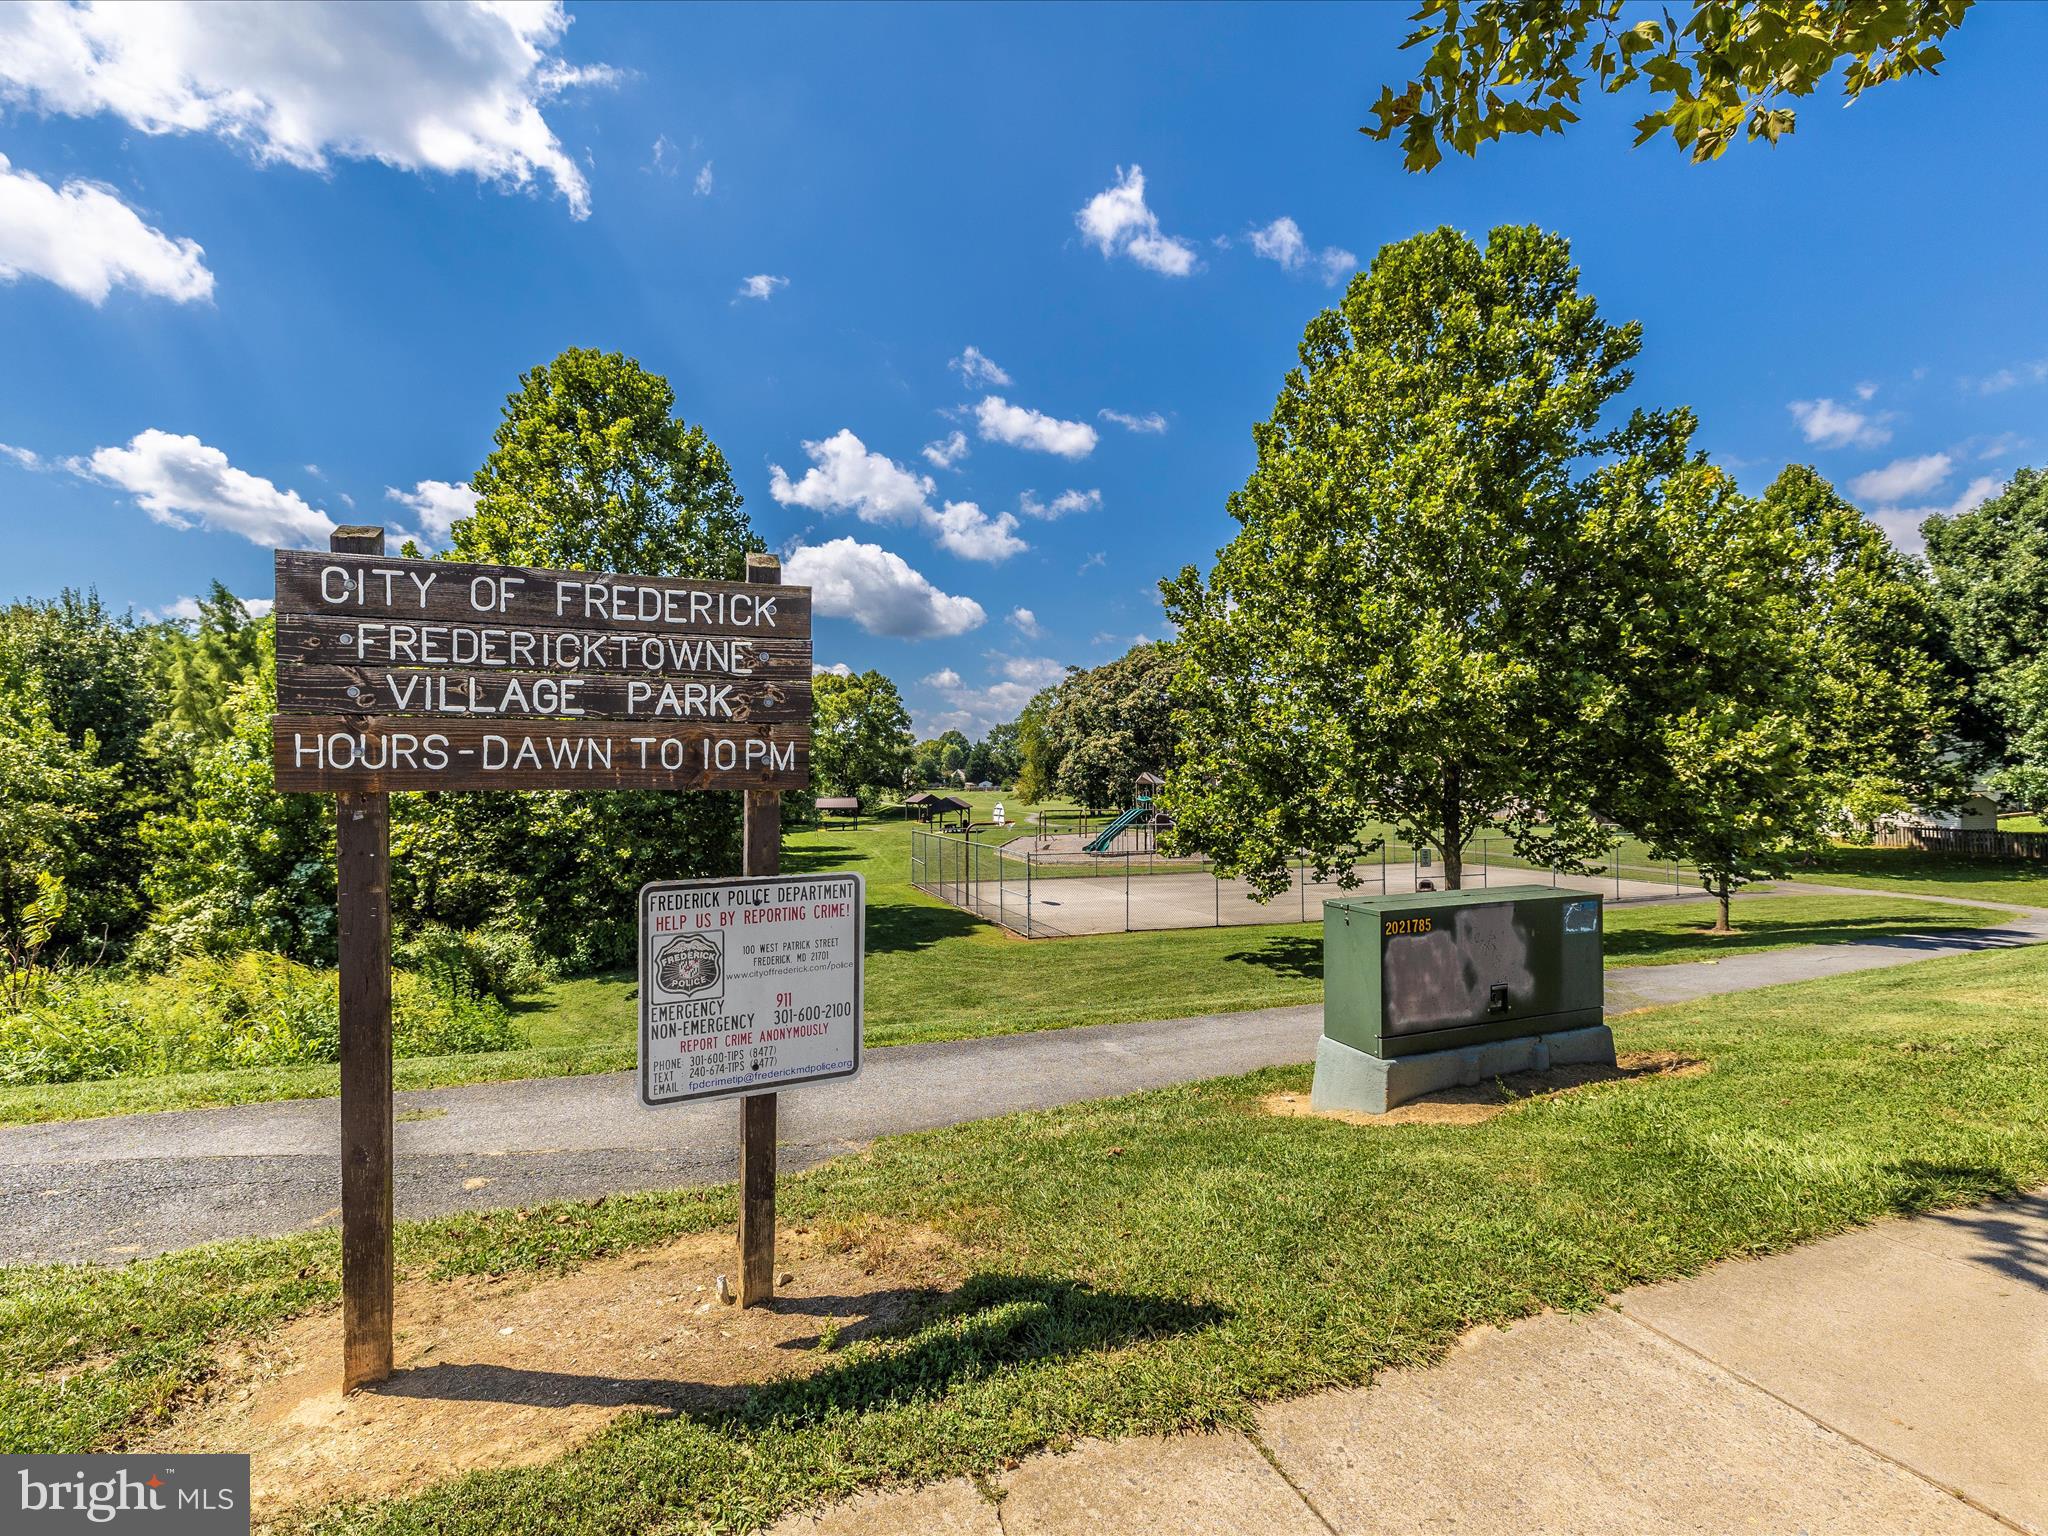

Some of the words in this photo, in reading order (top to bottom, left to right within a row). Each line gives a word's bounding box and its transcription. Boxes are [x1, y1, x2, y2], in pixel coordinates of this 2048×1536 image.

[321, 566, 436, 608] CITY
[470, 576, 525, 612] OF
[556, 582, 776, 627] FREDERICK
[358, 624, 752, 673] FREDERICKTOWNE
[386, 674, 585, 715] VILLAGE
[628, 682, 732, 717] PARK
[631, 737, 683, 771] TO
[650, 891, 720, 912] FREDERICK
[728, 888, 770, 906] POLICE
[778, 883, 854, 902] DEPARTMENT
[656, 915, 687, 931] HELP
[696, 913, 711, 928] US
[720, 911, 735, 927] BY
[744, 906, 806, 924] REPORTING
[814, 903, 850, 919] CRIME!
[1385, 918, 1432, 936] 2021785
[661, 951, 716, 967] FREDERICK
[743, 945, 755, 955] 100
[760, 943, 778, 953] WEST
[783, 940, 811, 951] PATRICK
[815, 938, 839, 949] STREET
[797, 953, 807, 963] MD
[811, 951, 829, 961] 21701
[672, 976, 707, 987] POLICE
[726, 961, 853, 980] www.cityoffrederick.com/police
[651, 1000, 725, 1023] EMERGENCY
[776, 992, 792, 1008] 911
[651, 1013, 755, 1041] NON-EMERGENCY
[774, 1002, 851, 1025] 301-600-2100
[680, 1037, 718, 1053] REPORT
[725, 1032, 753, 1047] CRIME
[760, 1022, 829, 1043] ANONYMOUSLY
[690, 1050, 744, 1067] 301-600-TIPS
[749, 1045, 777, 1058] (8477)
[653, 1071, 674, 1084] TEXT
[689, 1061, 745, 1079] 240-674-TIPS
[689, 1060, 853, 1091] fpdcrimetip@frederickmdpolice.org
